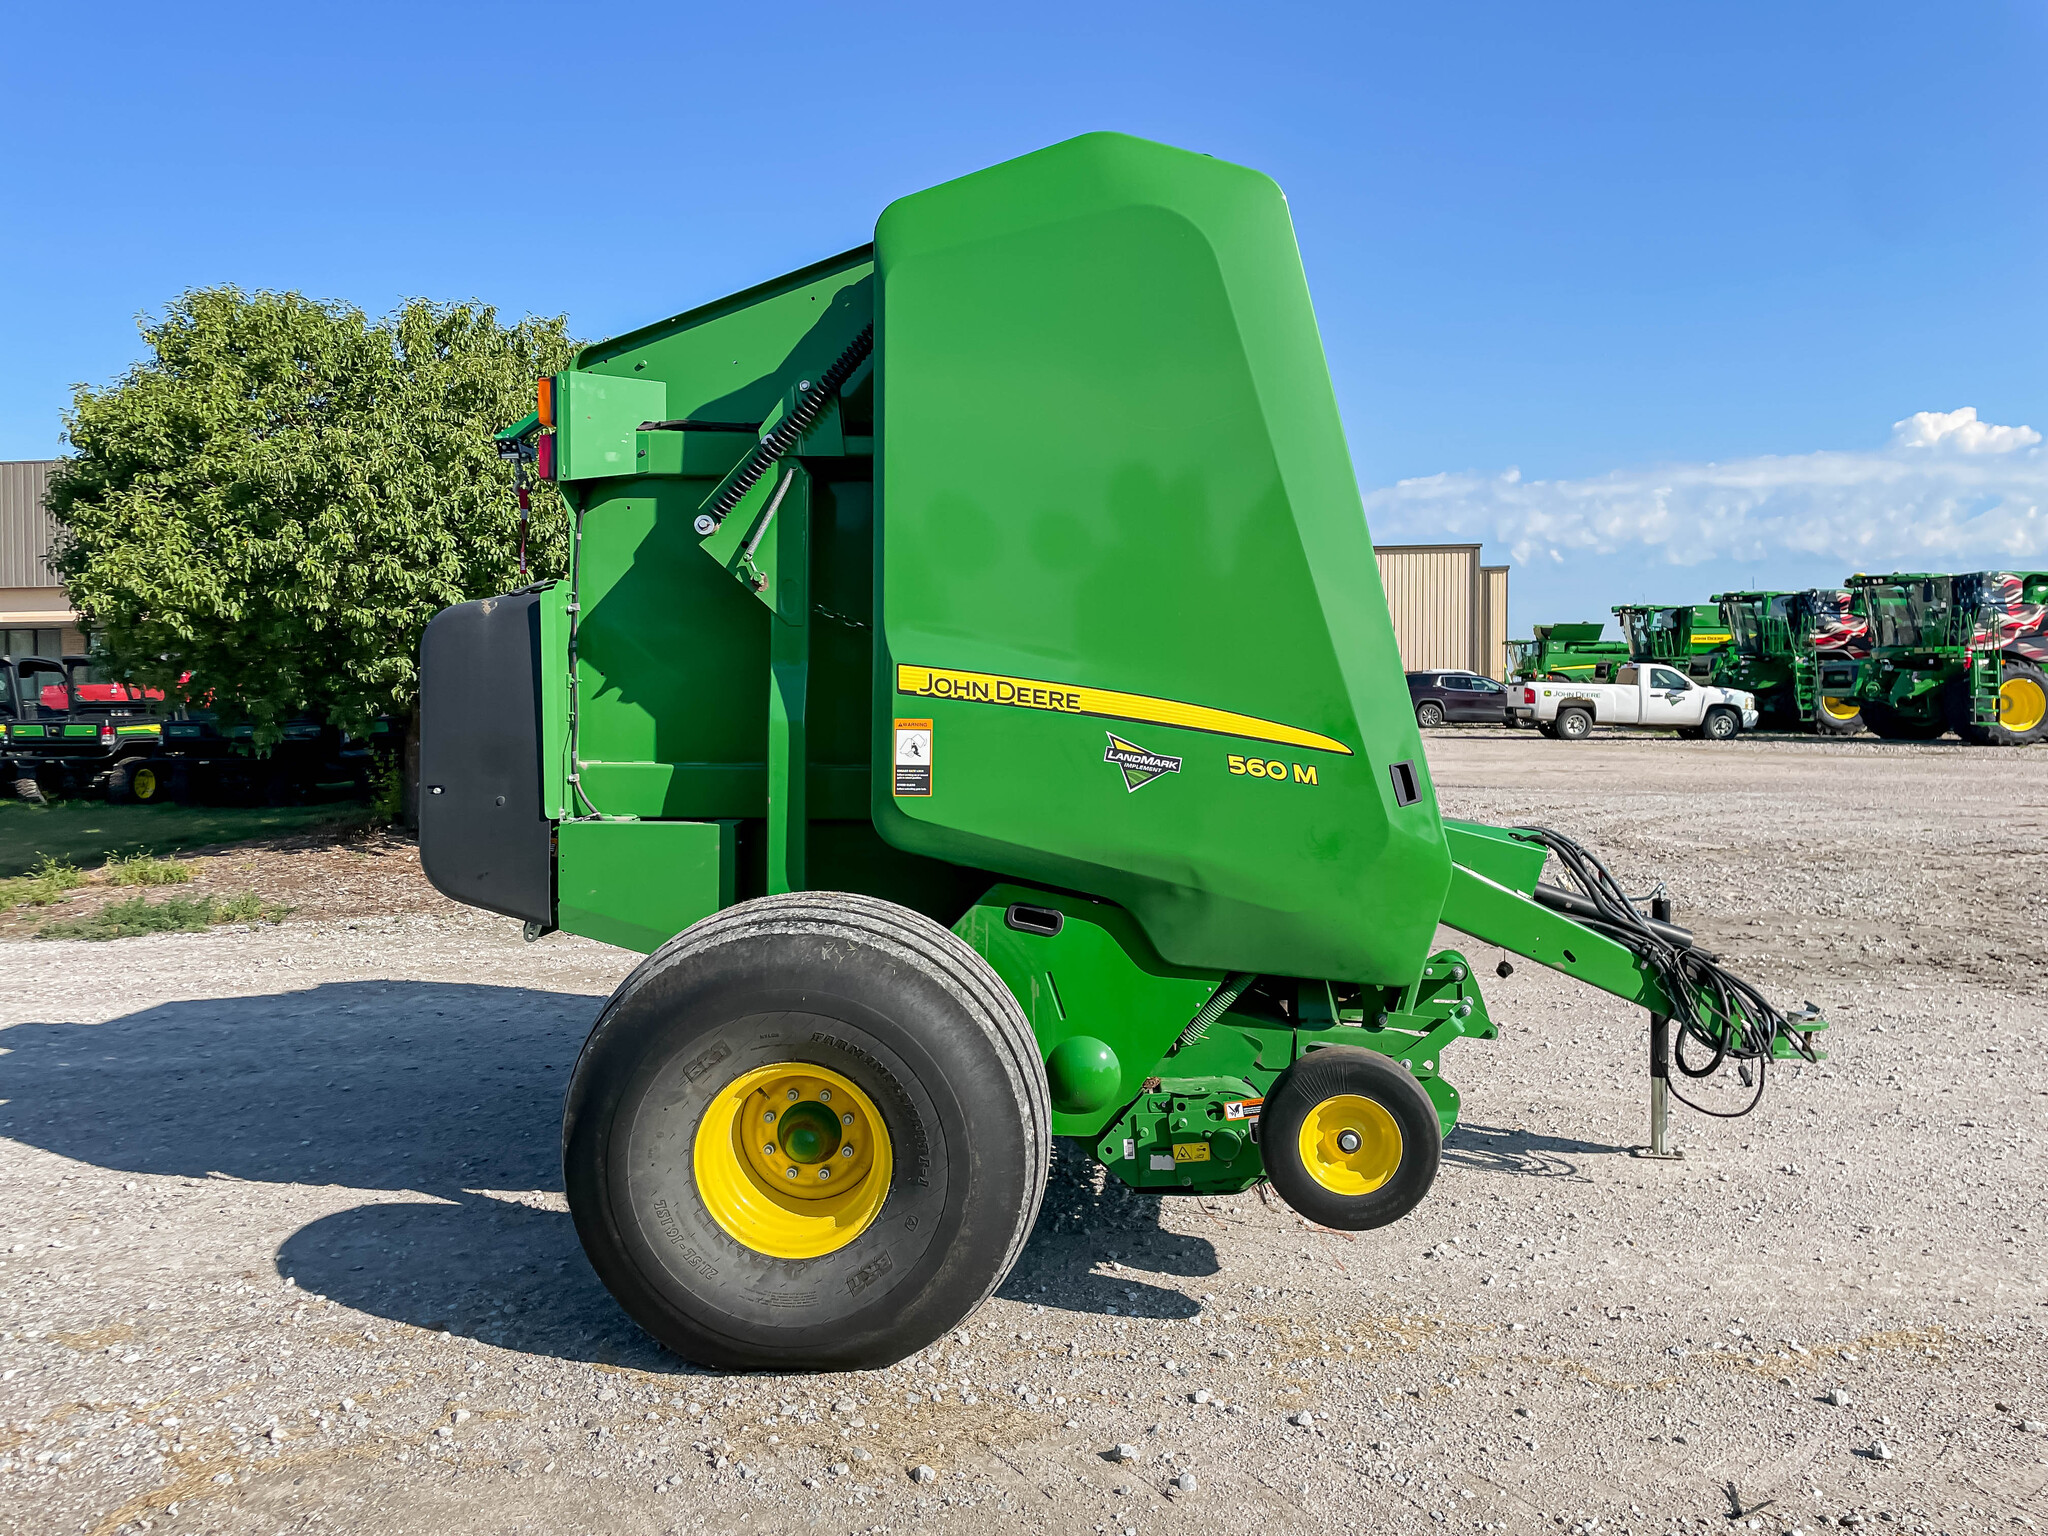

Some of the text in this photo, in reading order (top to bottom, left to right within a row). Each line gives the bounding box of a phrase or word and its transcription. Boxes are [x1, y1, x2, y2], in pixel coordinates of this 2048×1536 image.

[919, 673, 1081, 710] JOHN DEERE
[1553, 690, 1601, 699] JOHN DEERE
[1123, 762, 1163, 774] IMPLEMENT
[1226, 754, 1319, 786] 560 M
